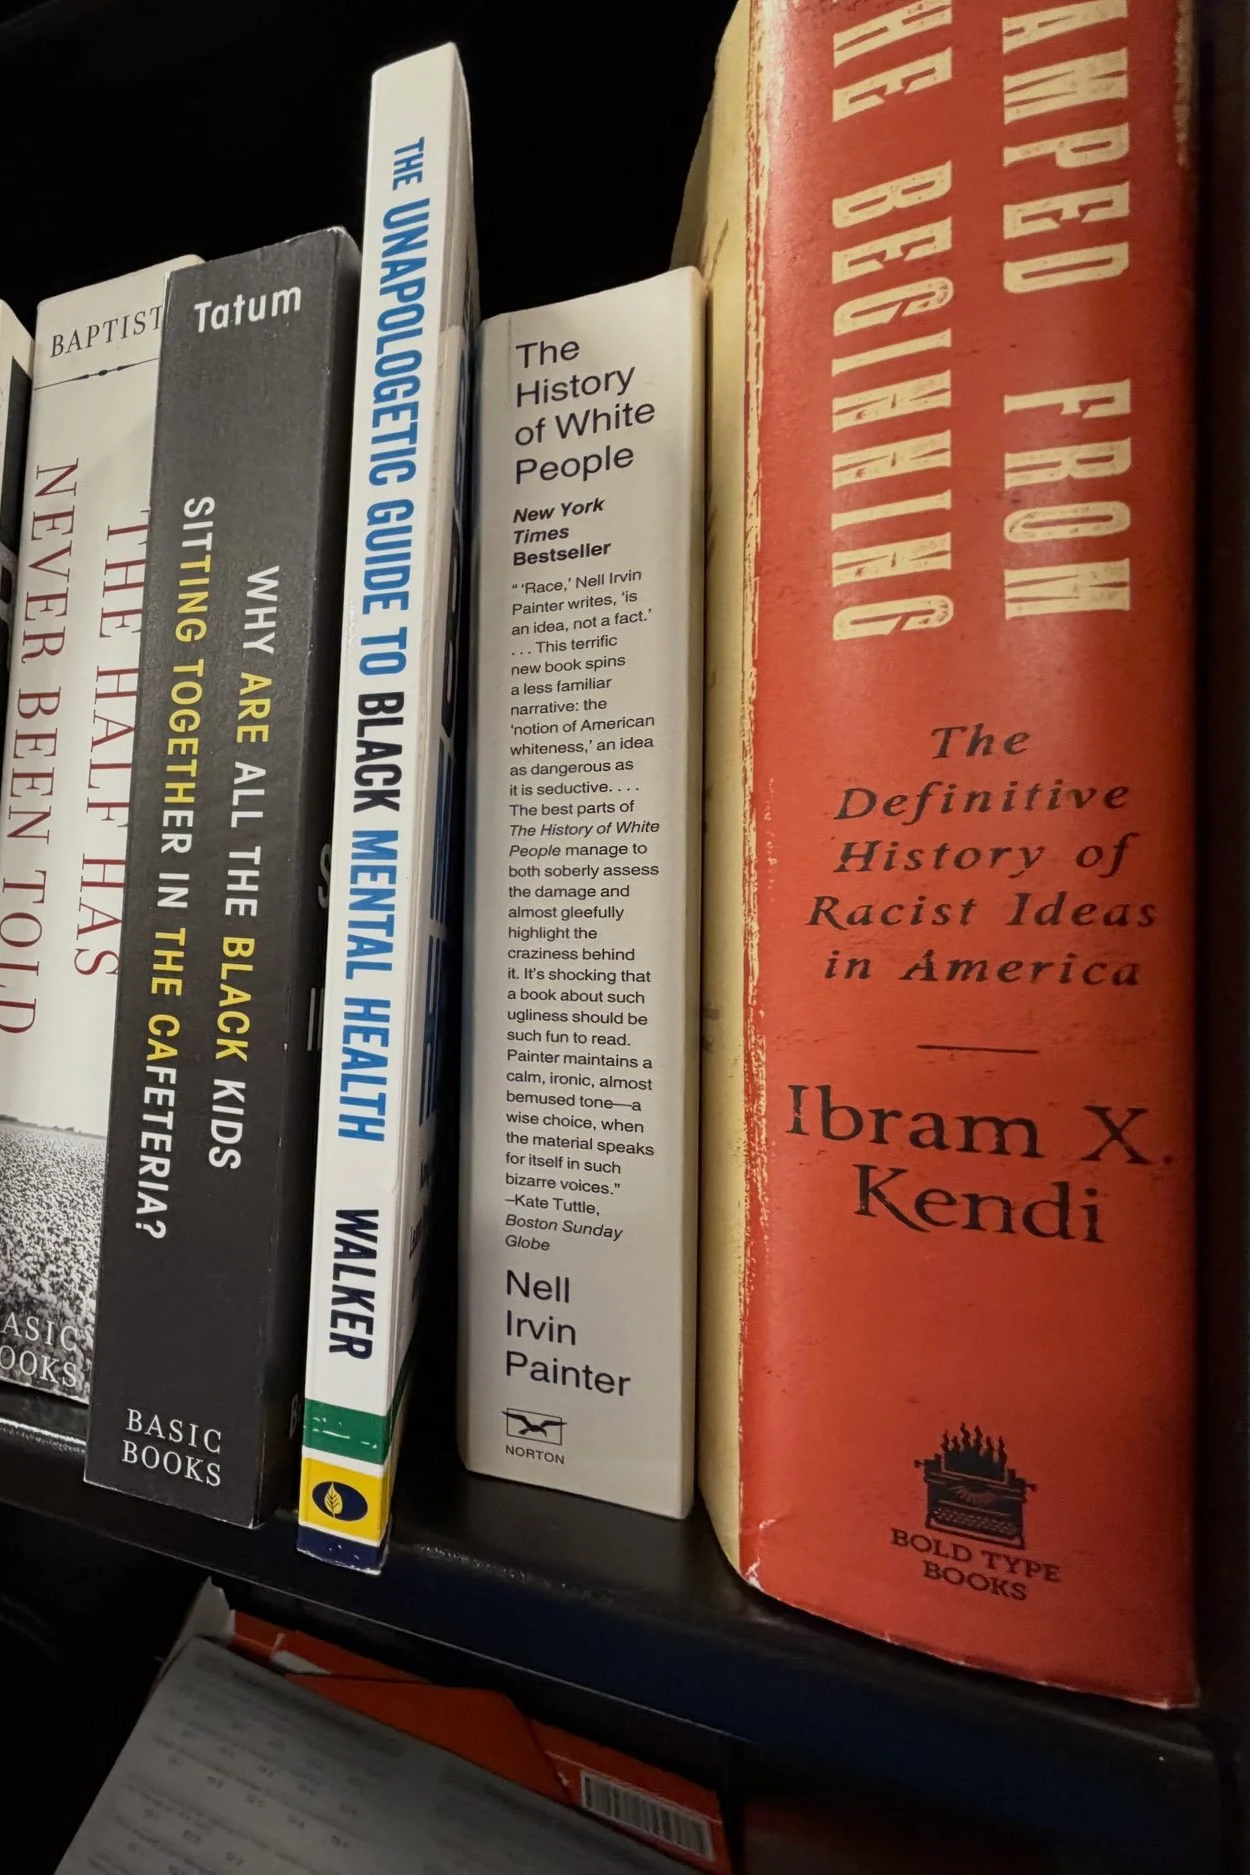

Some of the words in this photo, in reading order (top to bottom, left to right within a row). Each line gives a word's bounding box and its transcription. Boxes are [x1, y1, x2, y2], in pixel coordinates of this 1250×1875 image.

[392, 136, 425, 191] THE
[50, 304, 163, 358] BAPTIST
[194, 285, 302, 334] Tatum
[368, 197, 430, 487] UNAPOLOGETIC
[515, 340, 580, 369] The
[516, 366, 636, 408] History
[831, 159, 955, 641] BEGINNING
[515, 417, 546, 446] of
[555, 402, 656, 440] White
[515, 444, 635, 486] People
[513, 506, 555, 524] New
[561, 498, 606, 517] York
[1003, 378, 1132, 621] FROM
[21, 457, 79, 664] NEVER
[362, 498, 415, 615] GUIDE
[513, 543, 612, 566] Bestseller
[514, 527, 570, 545] Times
[99, 505, 150, 638] THE
[175, 496, 215, 643] SITTING
[242, 565, 280, 655] WHY
[358, 626, 408, 676] TO
[236, 672, 273, 743] ARE
[7, 686, 61, 844] BEEN
[86, 665, 139, 828] HALF
[161, 658, 204, 853] TOGETHER
[353, 691, 405, 814] BLACK
[510, 766, 527, 776] as
[531, 761, 611, 776] dangerous
[615, 760, 634, 771] as
[930, 722, 1030, 760] The
[230, 761, 266, 828] ALL
[509, 804, 537, 816] The
[542, 803, 573, 815] best
[577, 802, 615, 817] parts
[620, 800, 635, 813] of
[833, 779, 1130, 826] Definitive
[225, 845, 262, 917] THE
[832, 838, 1045, 879] History
[1075, 832, 1140, 879] of
[74, 853, 126, 976] HAS
[157, 873, 190, 909] IN
[345, 829, 399, 980] MENTAL
[805, 894, 978, 931] Racist
[1006, 891, 1158, 928] Ideas
[151, 927, 186, 996] THE
[824, 949, 871, 981] in
[898, 948, 1141, 987] America
[215, 936, 255, 1062] BLACK
[338, 997, 391, 1142] HEALTH
[135, 1013, 181, 1240] CAFETERIA?
[208, 1078, 246, 1170] KIDS
[785, 1084, 1045, 1159] Ibram
[1080, 1105, 1173, 1166] X.
[852, 1163, 1106, 1244] Kendi
[328, 1208, 379, 1361] WALKER
[506, 1269, 570, 1304] Nell
[506, 1309, 576, 1346] Irvin
[506, 1350, 631, 1397] Painter
[125, 1408, 222, 1454] BASIC
[505, 1444, 565, 1465] NORTON
[122, 1440, 221, 1487] BOOKS
[890, 1528, 972, 1563] BOLD
[981, 1550, 1061, 1583] TYPE
[922, 1560, 1028, 1601] BOOKS
